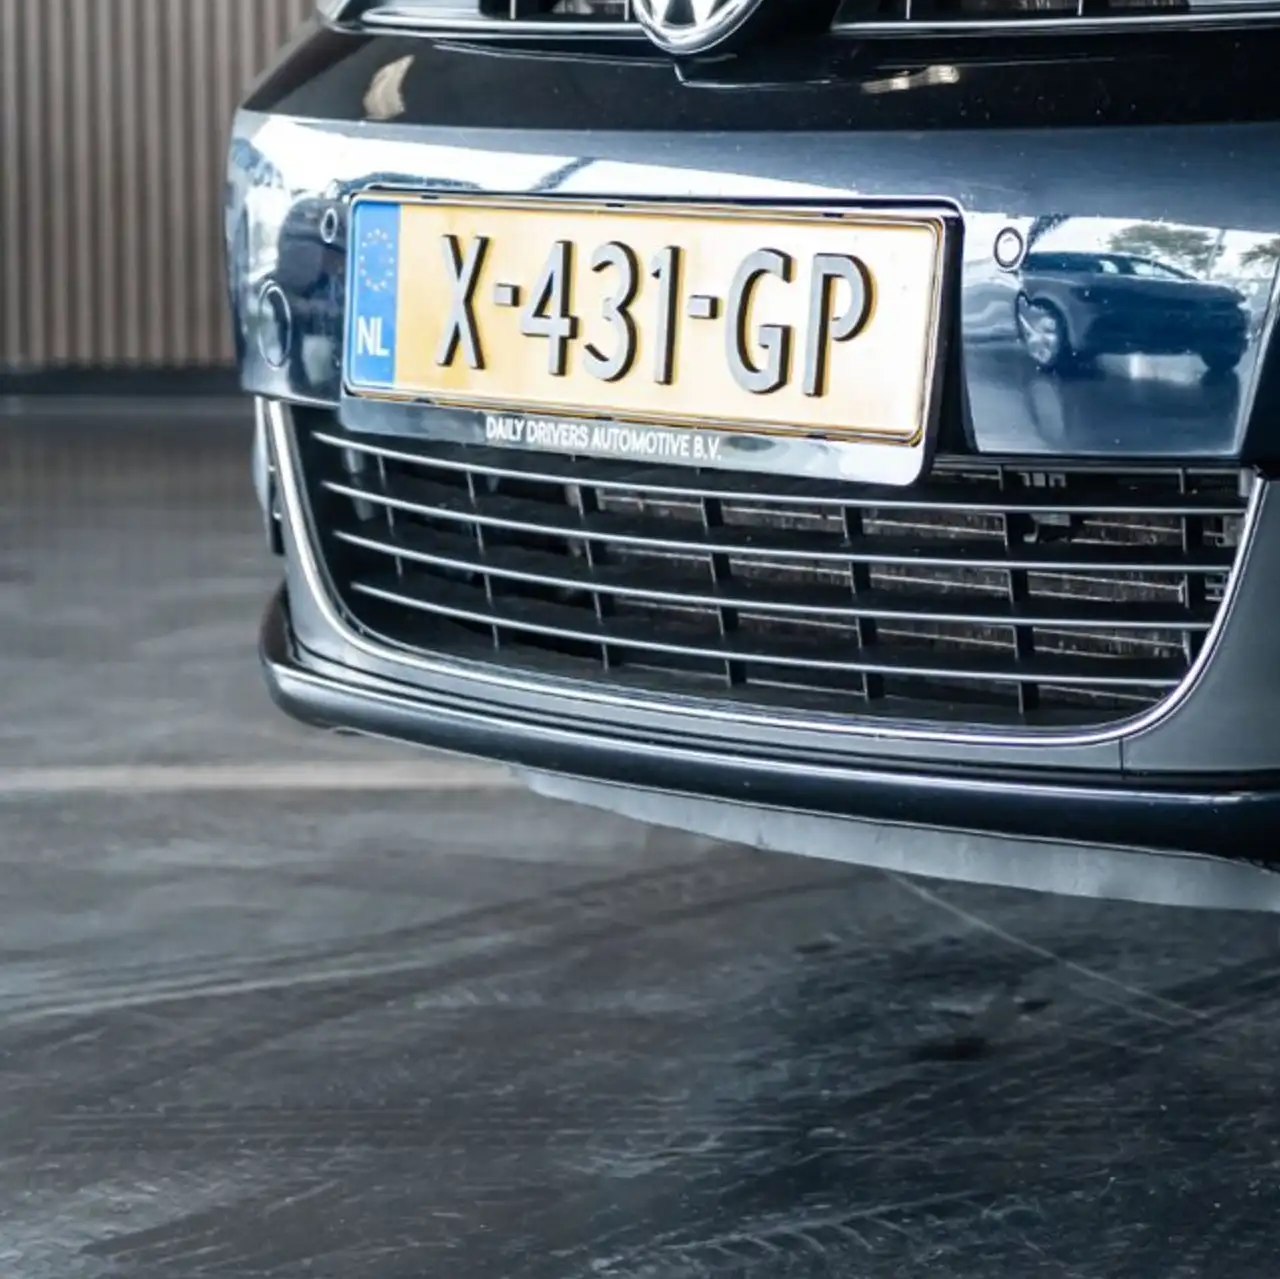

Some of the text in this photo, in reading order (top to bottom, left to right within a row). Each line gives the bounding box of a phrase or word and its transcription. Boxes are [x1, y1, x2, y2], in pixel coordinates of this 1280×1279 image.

[357, 315, 390, 357] NL
[437, 233, 877, 398] X-431-GP
[485, 415, 723, 461] DAILY DRIVERS AUTOMOTIVE B.V.
